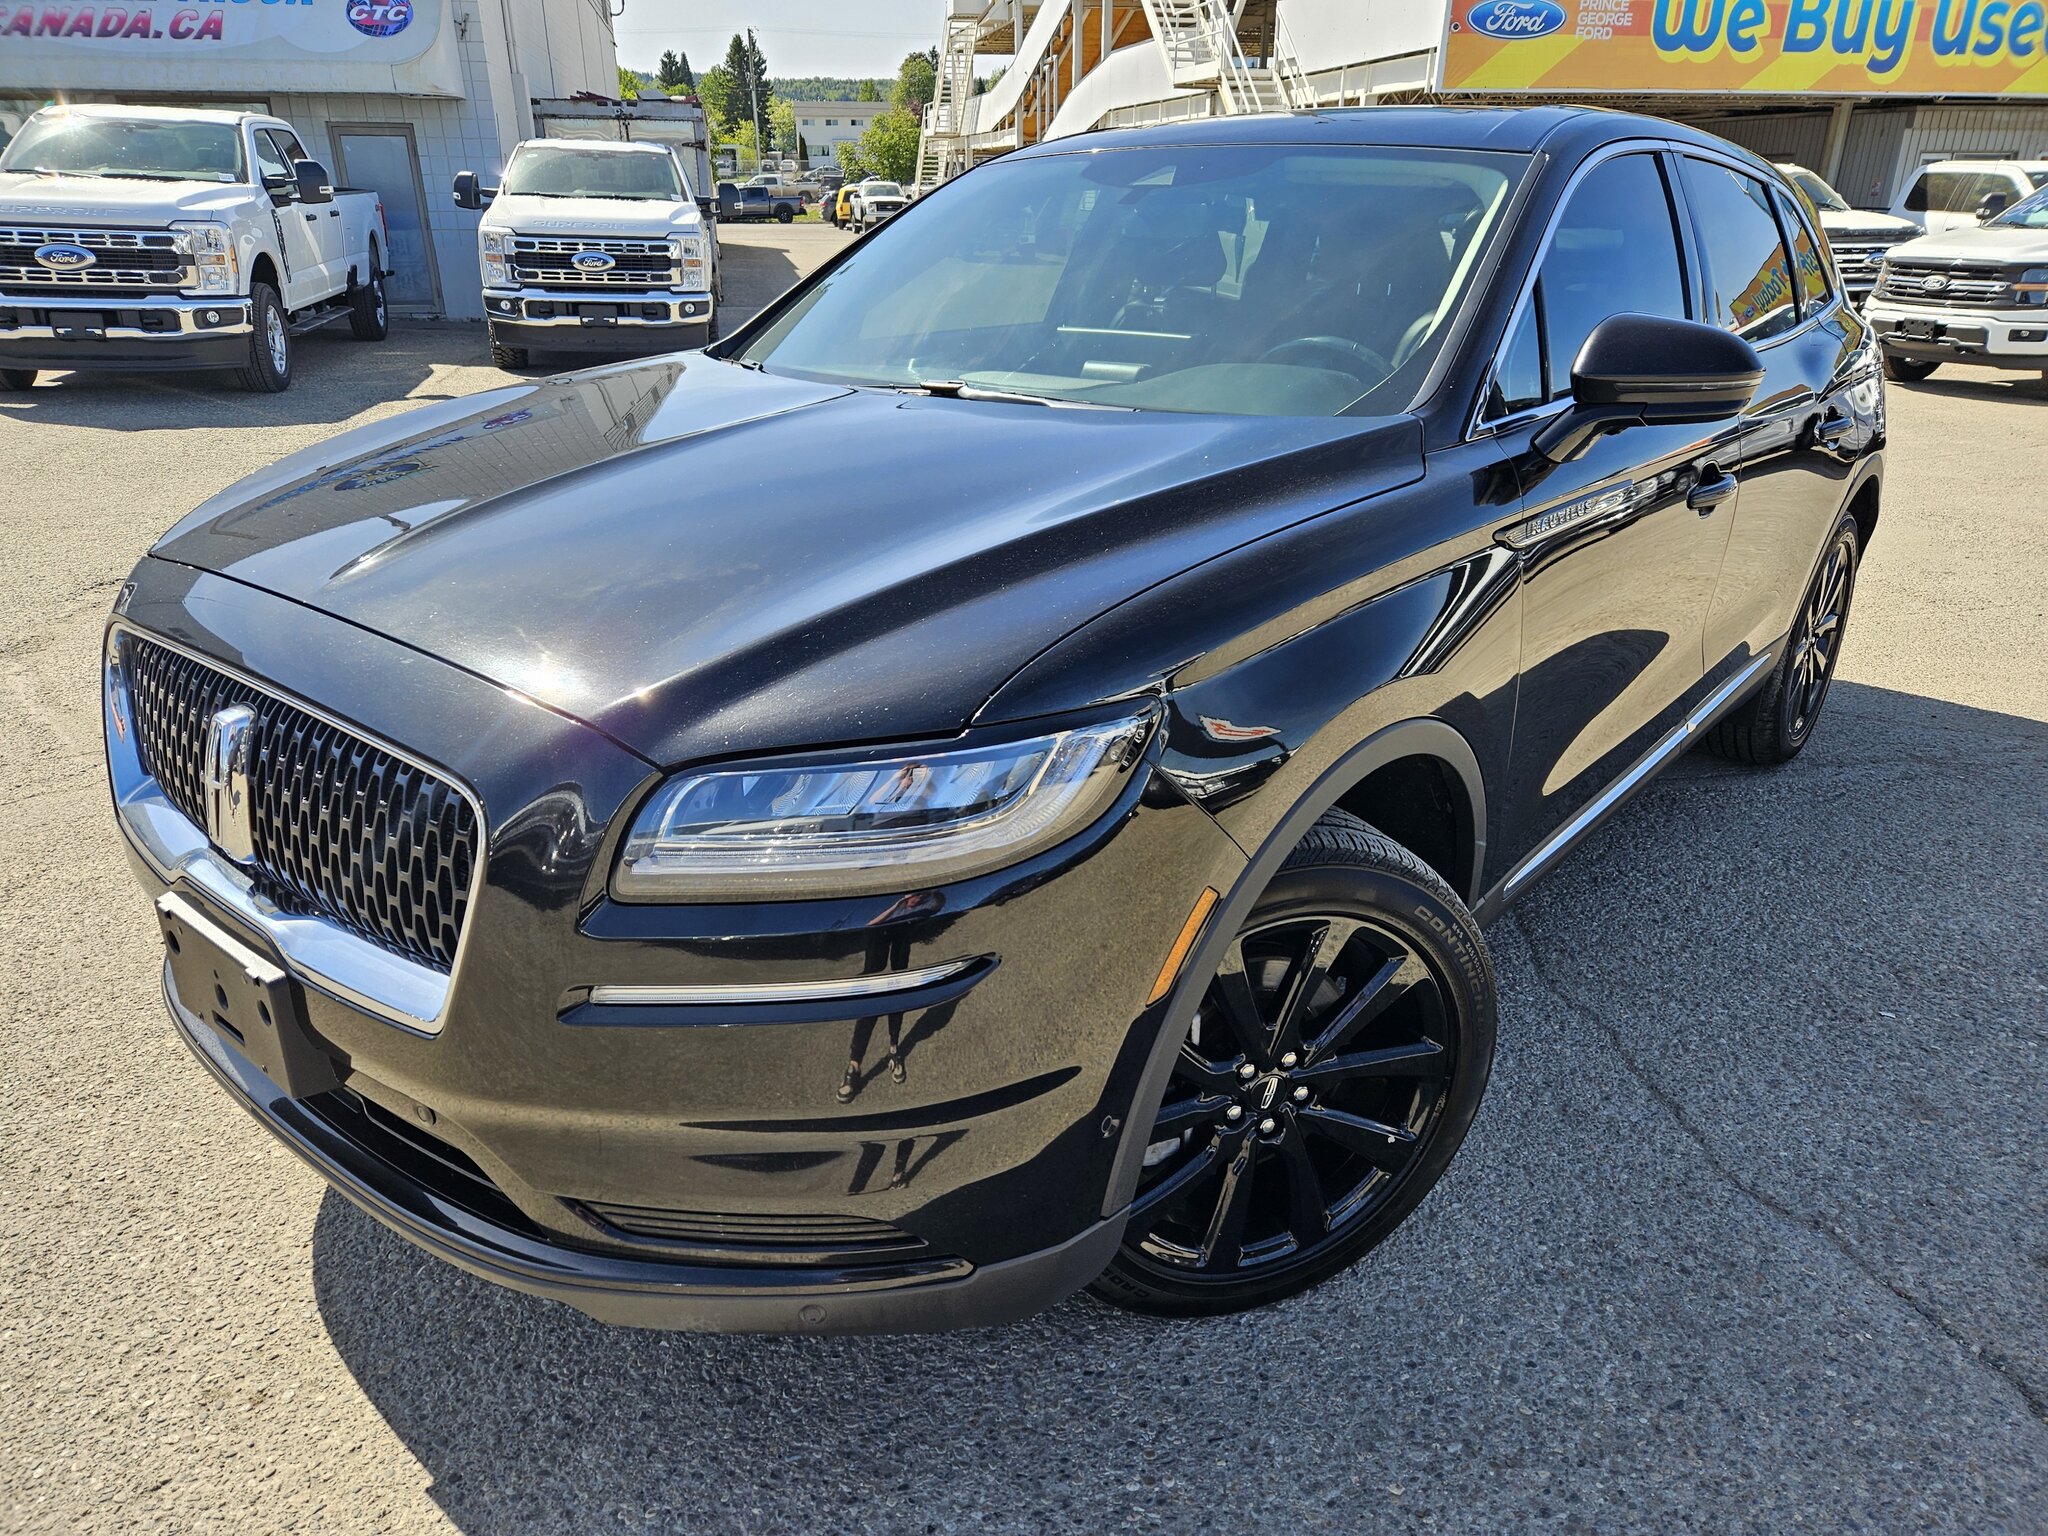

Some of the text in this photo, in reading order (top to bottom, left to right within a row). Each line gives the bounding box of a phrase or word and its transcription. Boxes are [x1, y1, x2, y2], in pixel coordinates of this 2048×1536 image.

[1579, 0, 1630, 11] PRINCE
[349, 5, 408, 21] CTC
[1485, 0, 1546, 33] Ford
[1577, 12, 1633, 26] GEORGE
[1575, 26, 1613, 40] FORD
[1652, 0, 2048, 74] We Buy Use
[49, 251, 78, 264] Ford
[582, 256, 604, 267] Ford
